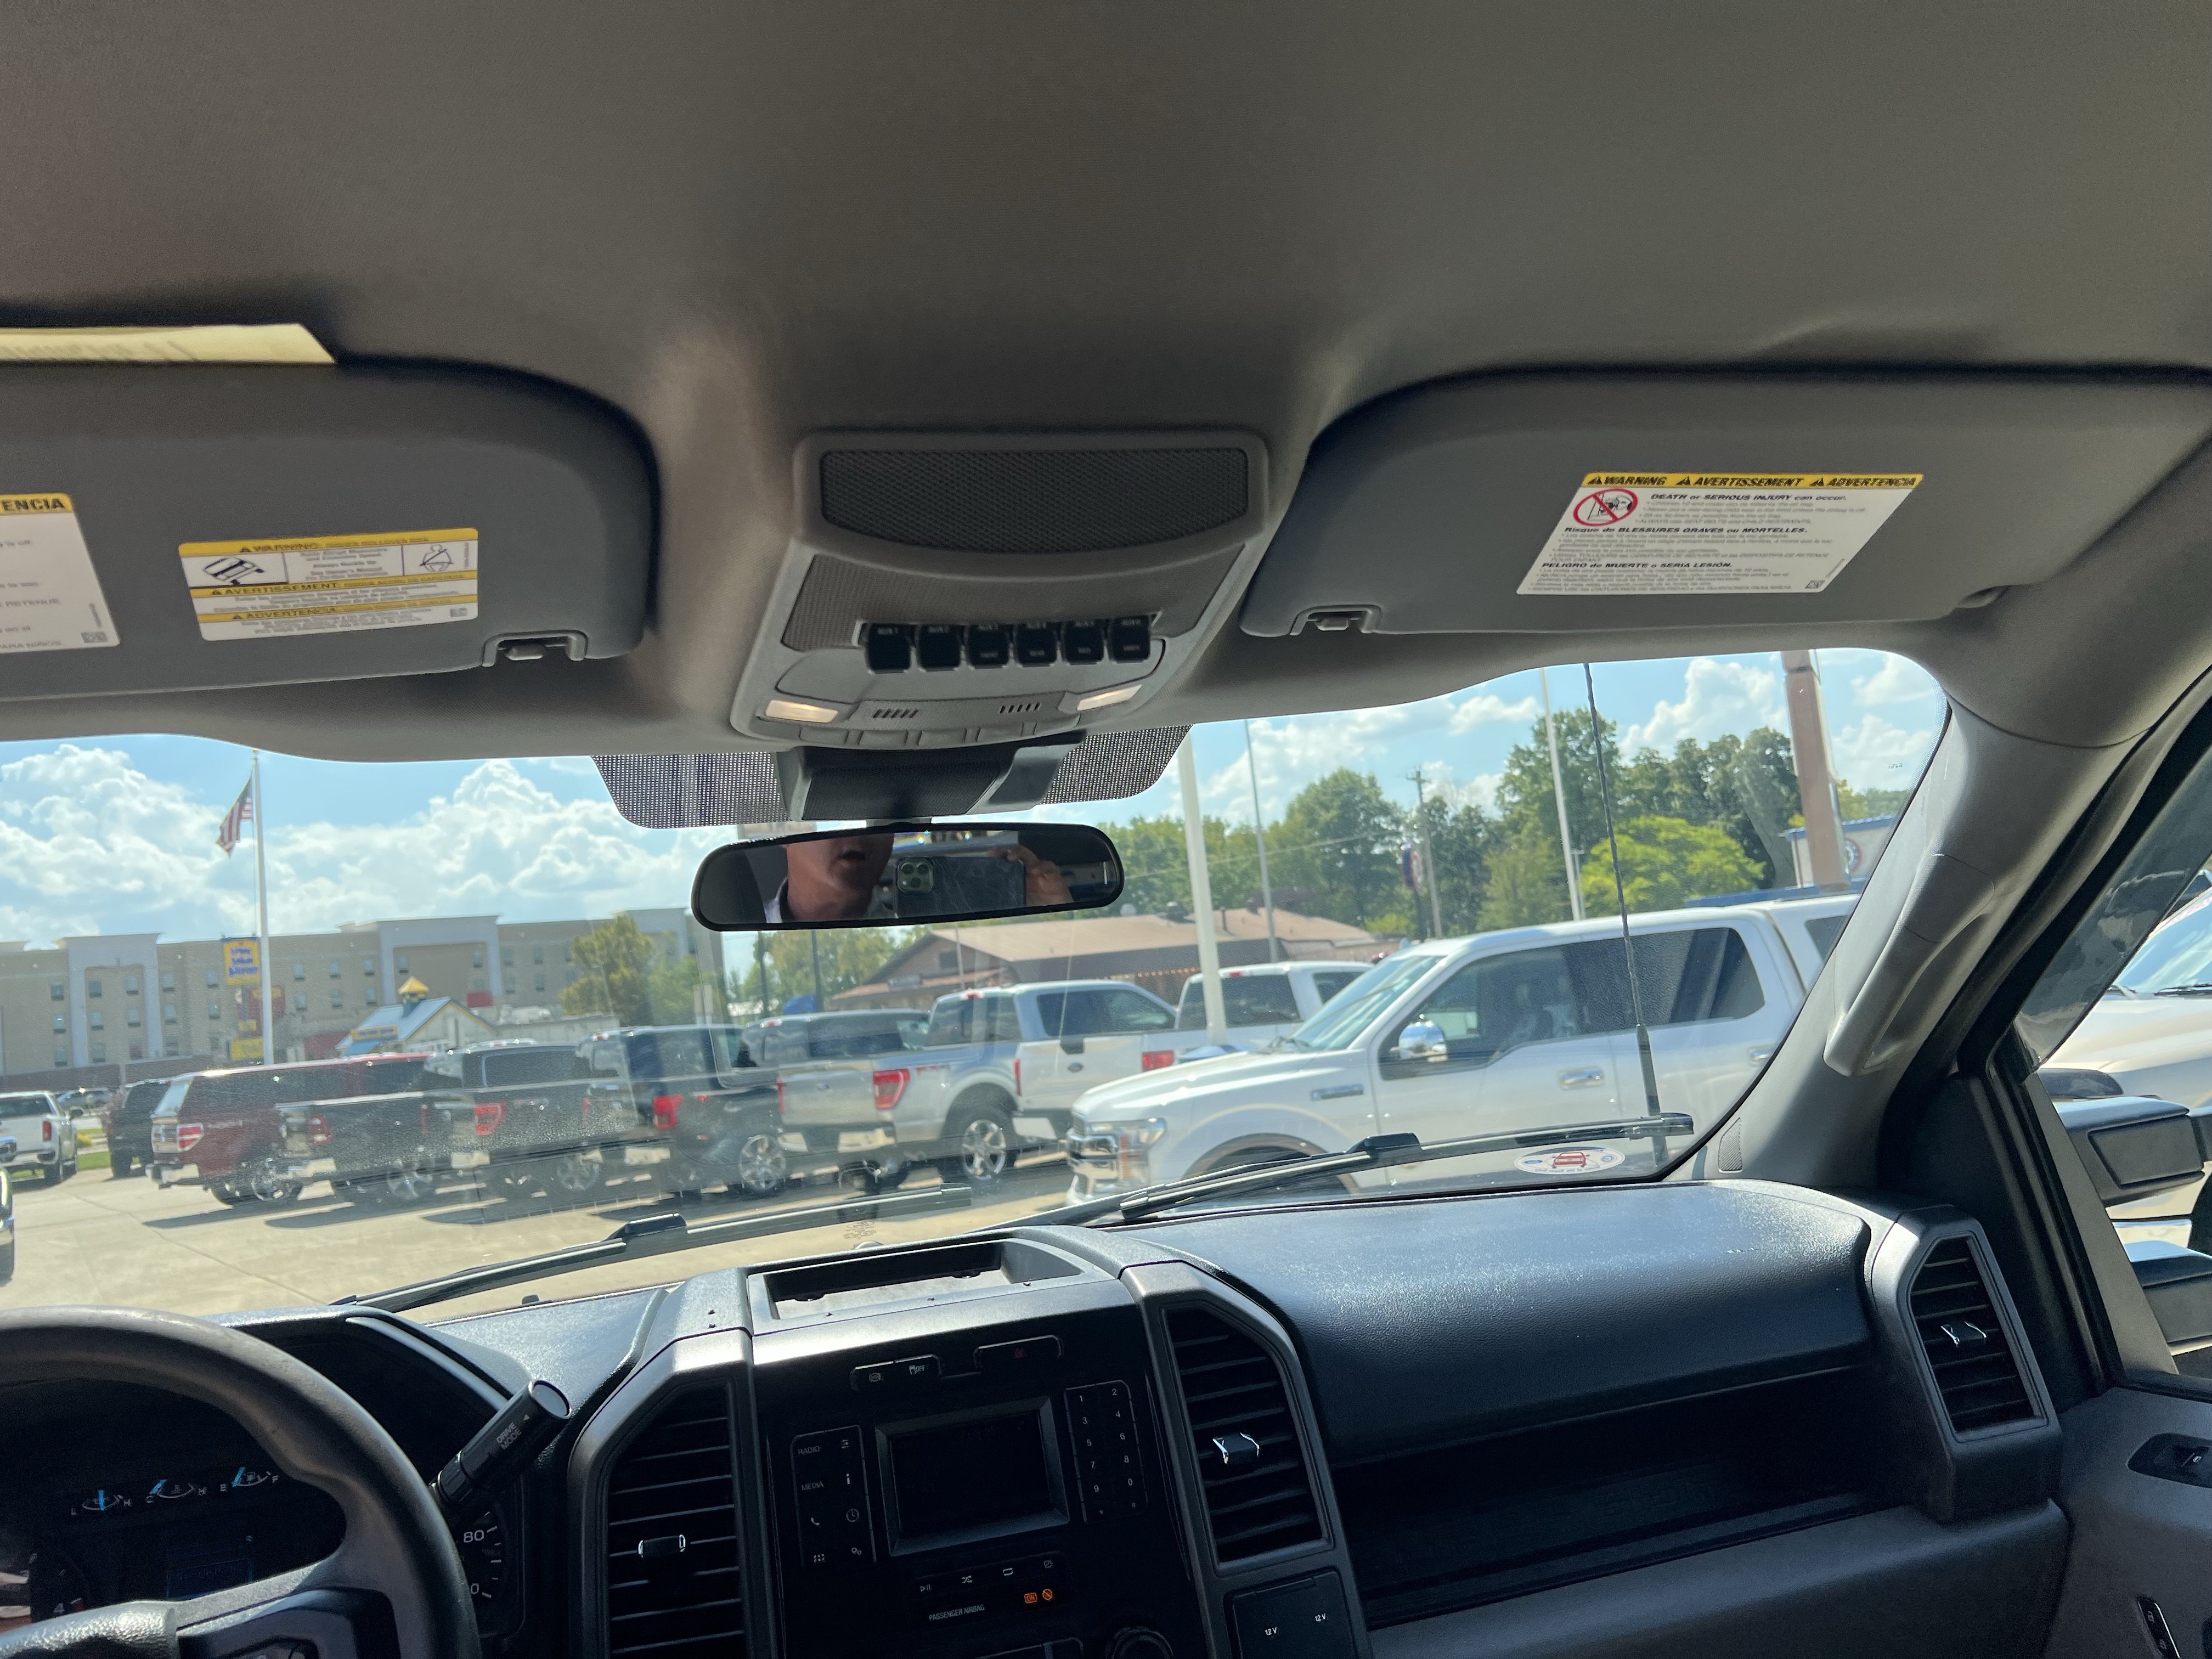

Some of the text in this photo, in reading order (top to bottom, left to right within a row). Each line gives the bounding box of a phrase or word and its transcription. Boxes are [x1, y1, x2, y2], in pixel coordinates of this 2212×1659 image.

[1604, 476, 1667, 485] WARNING
[1692, 477, 1805, 487] AVERTISSEMENT
[224, 583, 338, 594] AVERTISSEMENT
[916, 1364, 926, 1373] OFF
[1111, 1388, 1118, 1396] 2
[1115, 1410, 1121, 1418] 4
[1082, 1417, 1088, 1425] 3
[495, 1422, 517, 1443] DRIVE
[1120, 1432, 1125, 1440] 6
[500, 1427, 522, 1450] MODE
[1086, 1438, 1092, 1447] 5
[797, 1446, 821, 1455] RADIO
[1124, 1455, 1130, 1464] 8
[1090, 1460, 1096, 1469] 7
[801, 1481, 825, 1491] MEDIA
[1127, 1477, 1133, 1486] 0
[1093, 1484, 1099, 1493] 9
[462, 1529, 485, 1543] 80
[928, 1604, 986, 1622] PASSENGER AIRBAG
